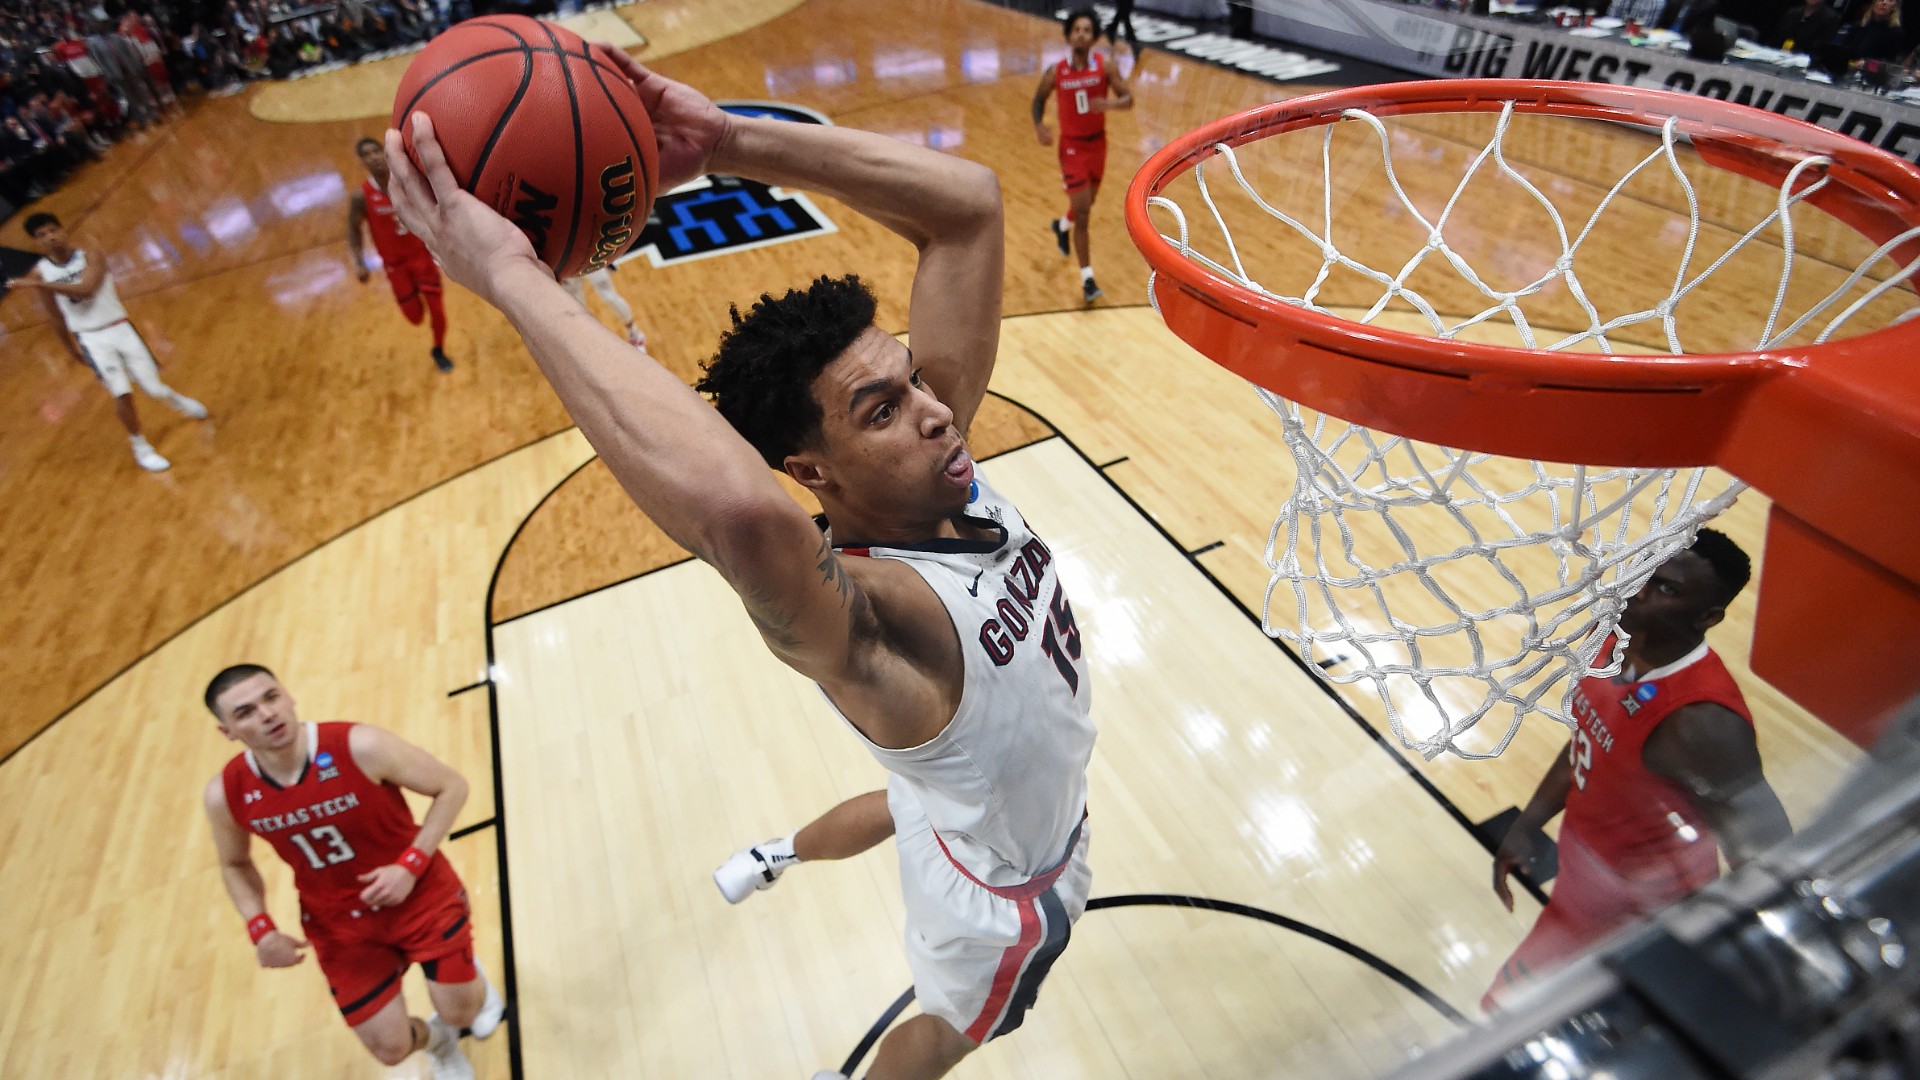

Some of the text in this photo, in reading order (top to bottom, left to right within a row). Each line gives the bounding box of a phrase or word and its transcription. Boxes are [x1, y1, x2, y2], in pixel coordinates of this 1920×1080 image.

[1444, 25, 1514, 78] BIG
[1522, 41, 1652, 86] WEST
[1075, 89, 1089, 114] 0
[1041, 576, 1081, 697] 15
[1586, 708, 1615, 753] TECH
[250, 792, 360, 833] TEXAS TECH
[290, 824, 355, 870] 13
